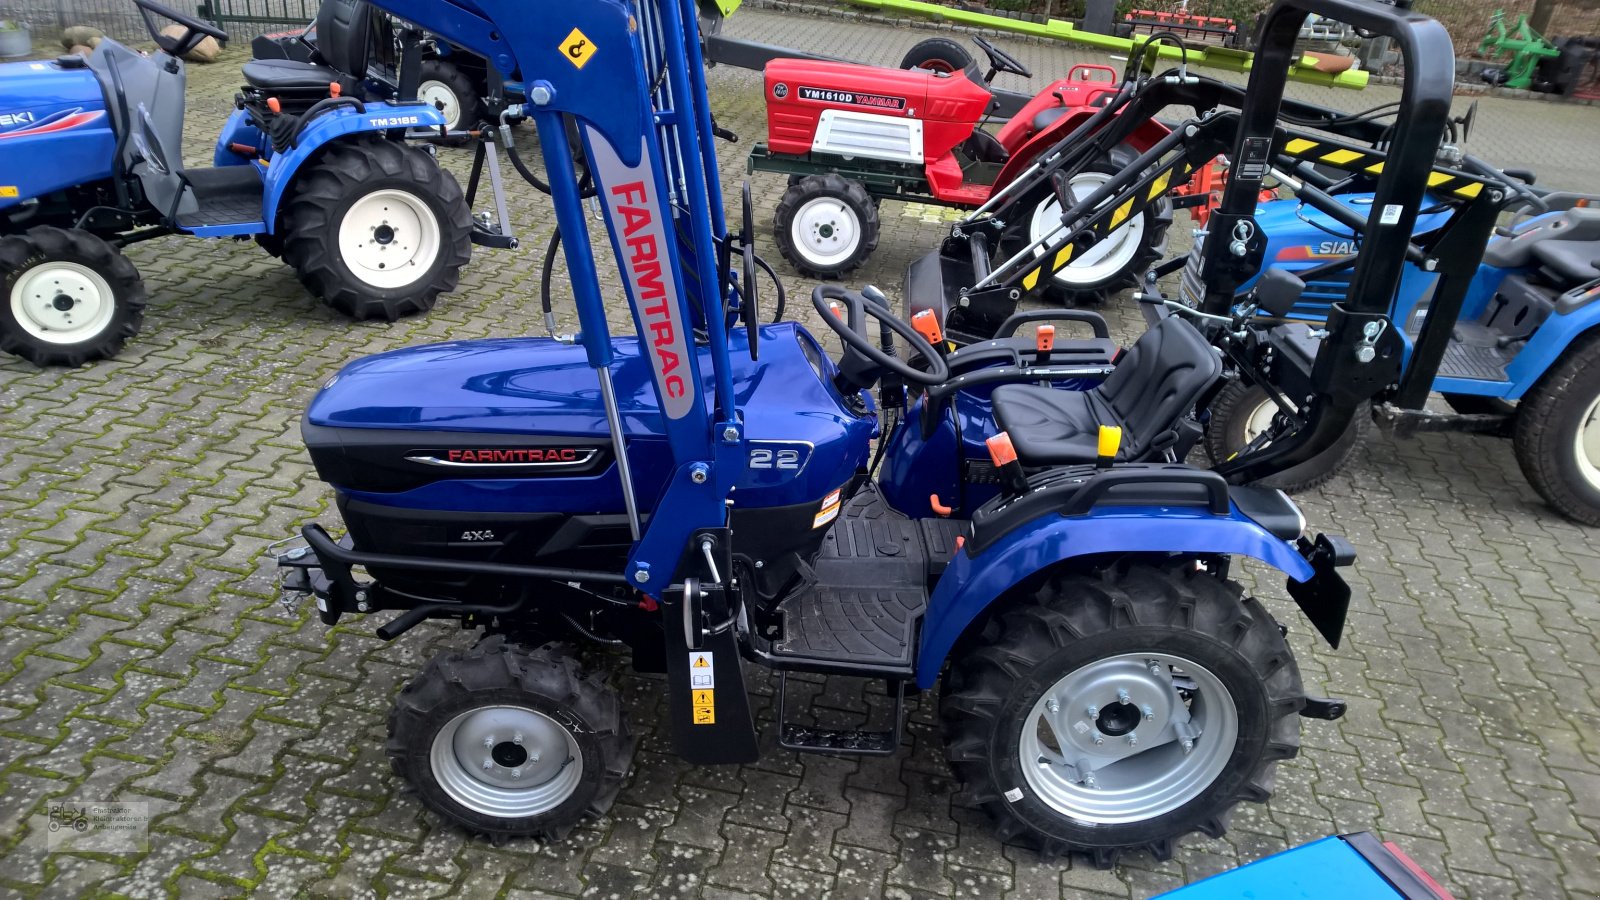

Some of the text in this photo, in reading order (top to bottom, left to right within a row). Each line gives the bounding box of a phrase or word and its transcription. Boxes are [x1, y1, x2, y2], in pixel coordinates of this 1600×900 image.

[804, 89, 900, 109] YM1610D YANMAR
[369, 116, 418, 127] TM 3185
[611, 181, 685, 399] FARMTRAC
[449, 449, 576, 462] FARMTRAC
[749, 449, 799, 469] 22
